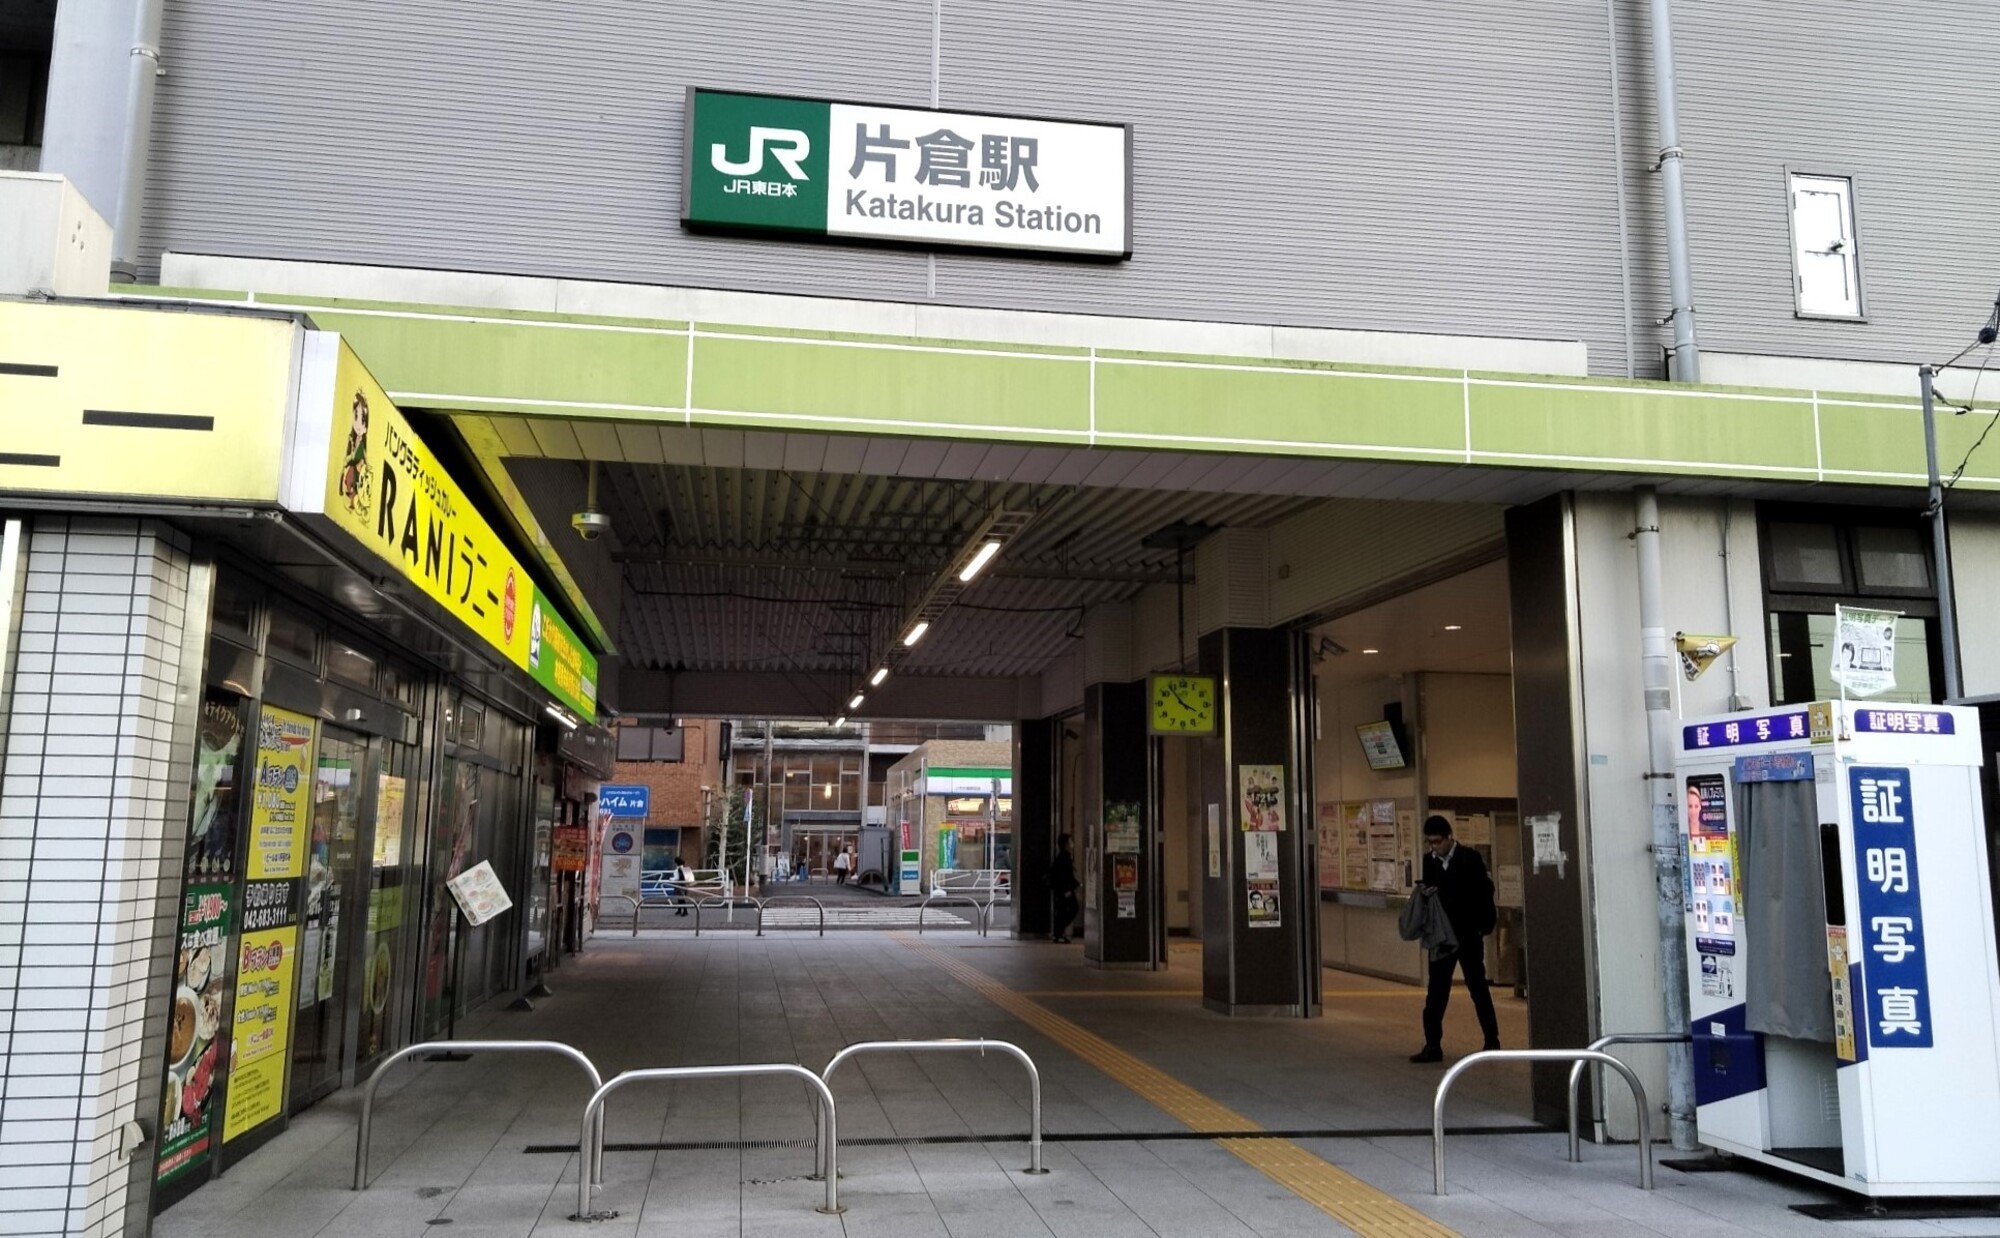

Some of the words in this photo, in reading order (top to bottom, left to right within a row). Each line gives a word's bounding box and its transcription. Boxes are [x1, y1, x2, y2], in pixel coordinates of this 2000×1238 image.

[711, 126, 810, 181] JR
[848, 123, 1040, 194] 片倉駅
[723, 179, 798, 198] JR東日本
[846, 189, 985, 226] Katakura
[995, 201, 1102, 235] Station
[1696, 715, 1806, 747] 証明写真
[1868, 711, 1941, 734] 証明写真
[243, 906, 288, 930] 042-683-3111
[1859, 778, 1922, 1036] 証明写真
